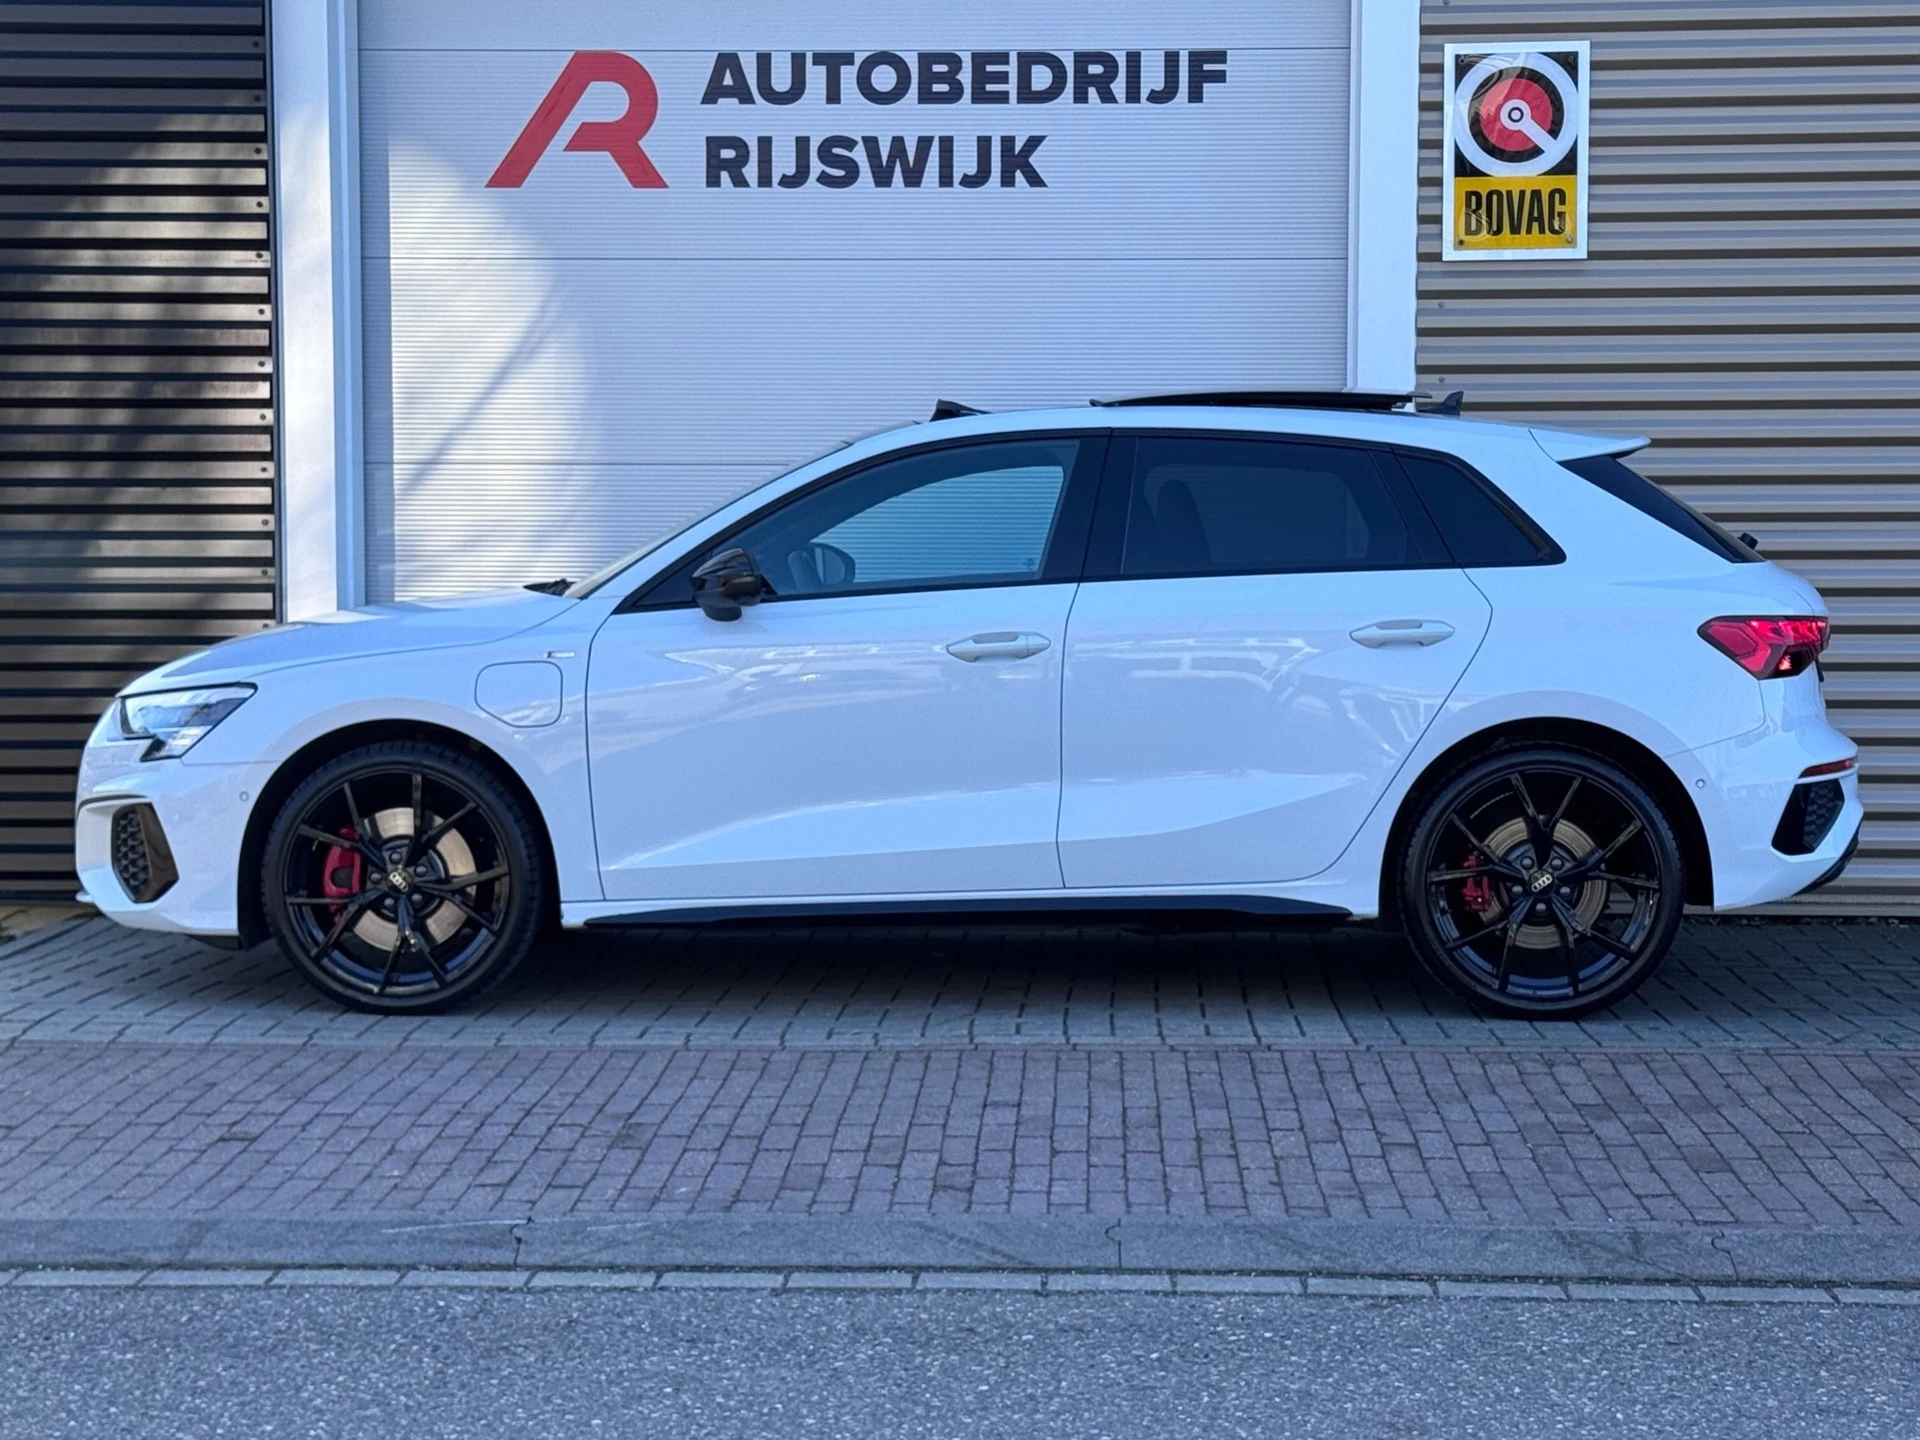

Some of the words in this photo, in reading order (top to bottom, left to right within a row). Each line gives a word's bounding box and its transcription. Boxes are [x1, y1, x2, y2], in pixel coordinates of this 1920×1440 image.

[700, 51, 1228, 105] AUTOBEDRIJF
[705, 135, 1049, 189] RIJSWIJK
[1464, 188, 1567, 237] BOVAG
